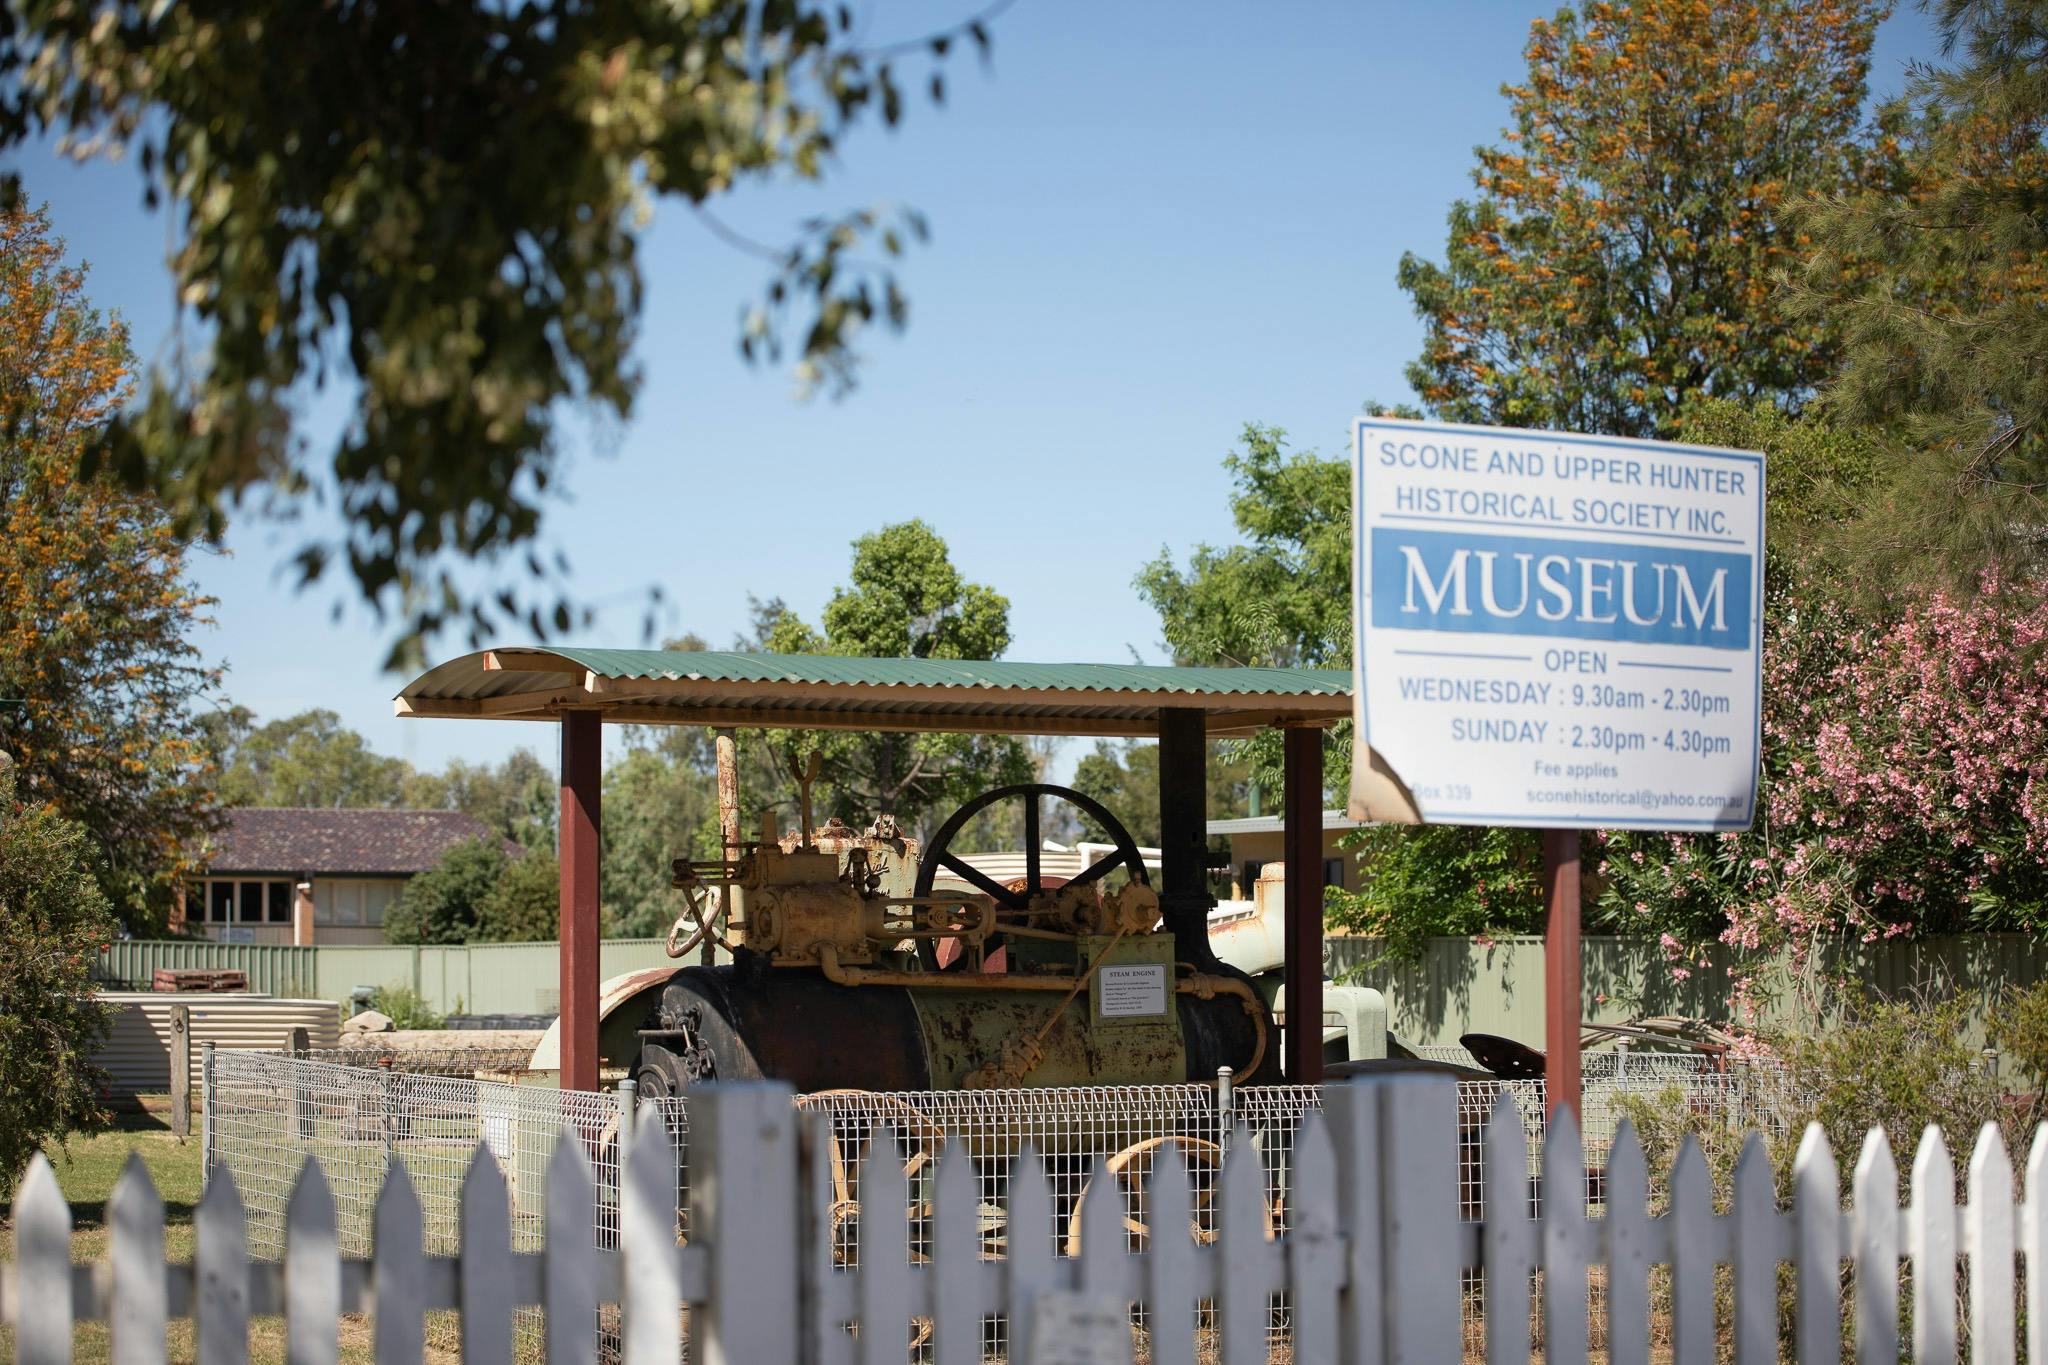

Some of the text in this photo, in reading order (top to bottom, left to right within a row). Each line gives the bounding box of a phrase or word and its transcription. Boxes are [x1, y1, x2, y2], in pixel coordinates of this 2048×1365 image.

[1380, 441, 1746, 496] SCONE AND UPPER HUNTER
[1396, 486, 1733, 536] HISTORICAL SOCIETY INC.
[1399, 545, 1729, 632] MUSEUM
[1544, 649, 1608, 675] OPEN
[1399, 677, 1551, 705] WEDNESDAY
[1572, 685, 1645, 710] 9.30am
[1663, 688, 1730, 716] 2.30pm
[1452, 718, 1548, 744] SUNDAY
[1571, 725, 1645, 754] 2.30pm
[1663, 729, 1731, 758] 4.30pm
[1534, 760, 1618, 780] Fee applies
[1527, 788, 1743, 809] sconehistorical@yahoo.com.au
